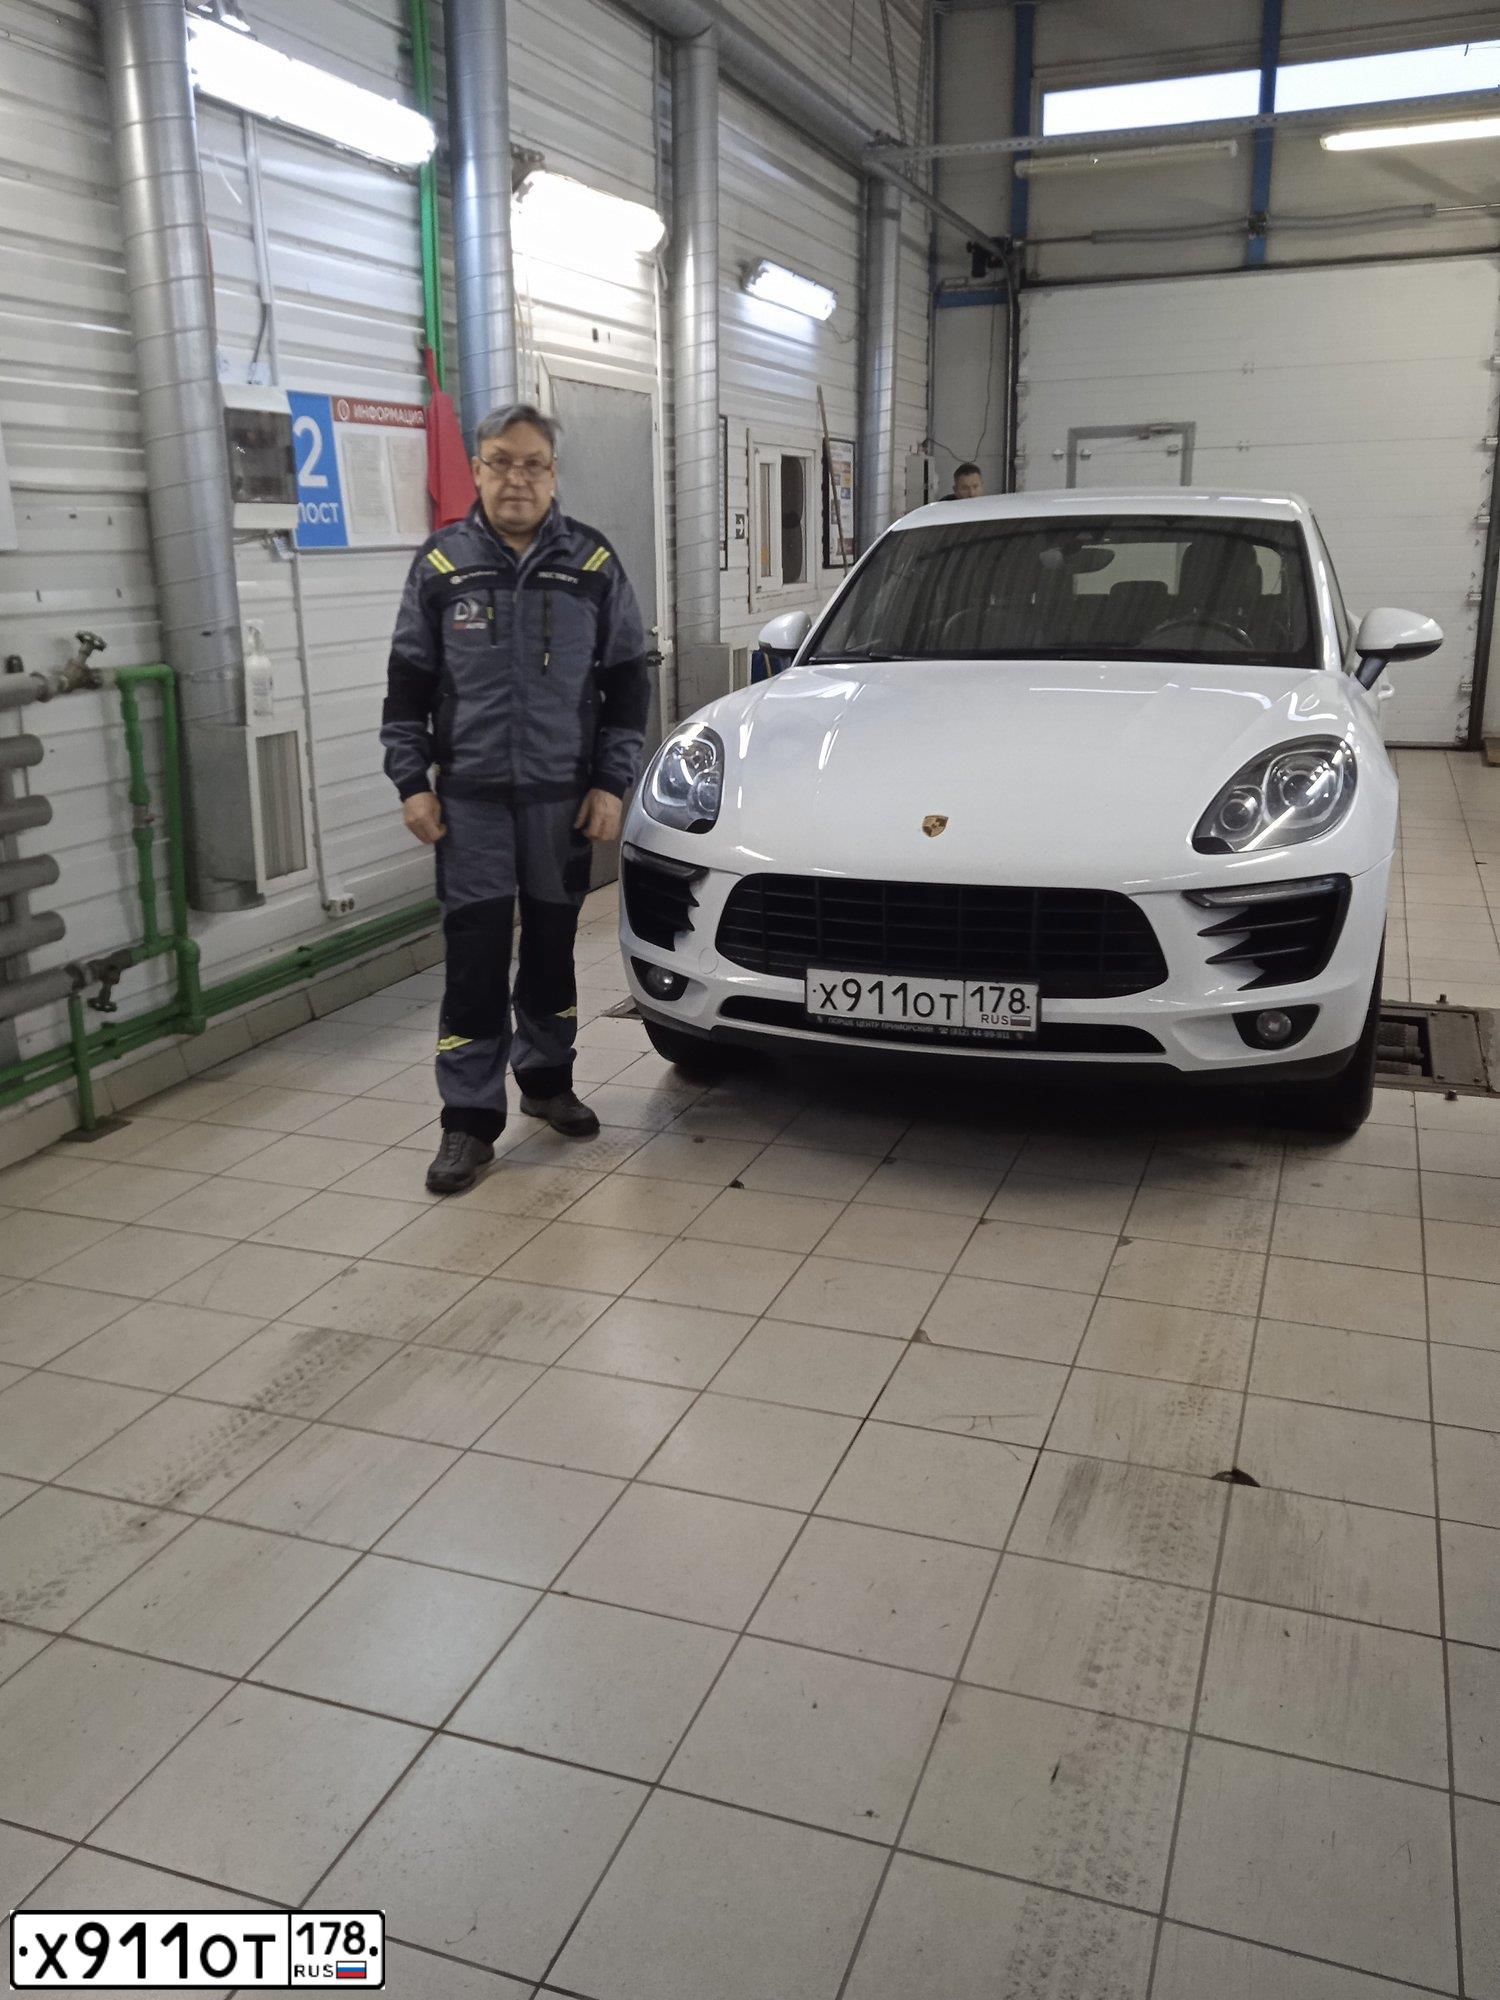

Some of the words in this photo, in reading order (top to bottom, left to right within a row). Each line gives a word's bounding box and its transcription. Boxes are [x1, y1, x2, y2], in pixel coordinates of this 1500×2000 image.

[353, 403, 424, 425] ИНФОРМАЦИЯ
[293, 416, 328, 487] 2
[819, 978, 958, 1020] Х911ОТ
[970, 985, 1025, 1015] 178
[981, 1013, 1009, 1026] RUS
